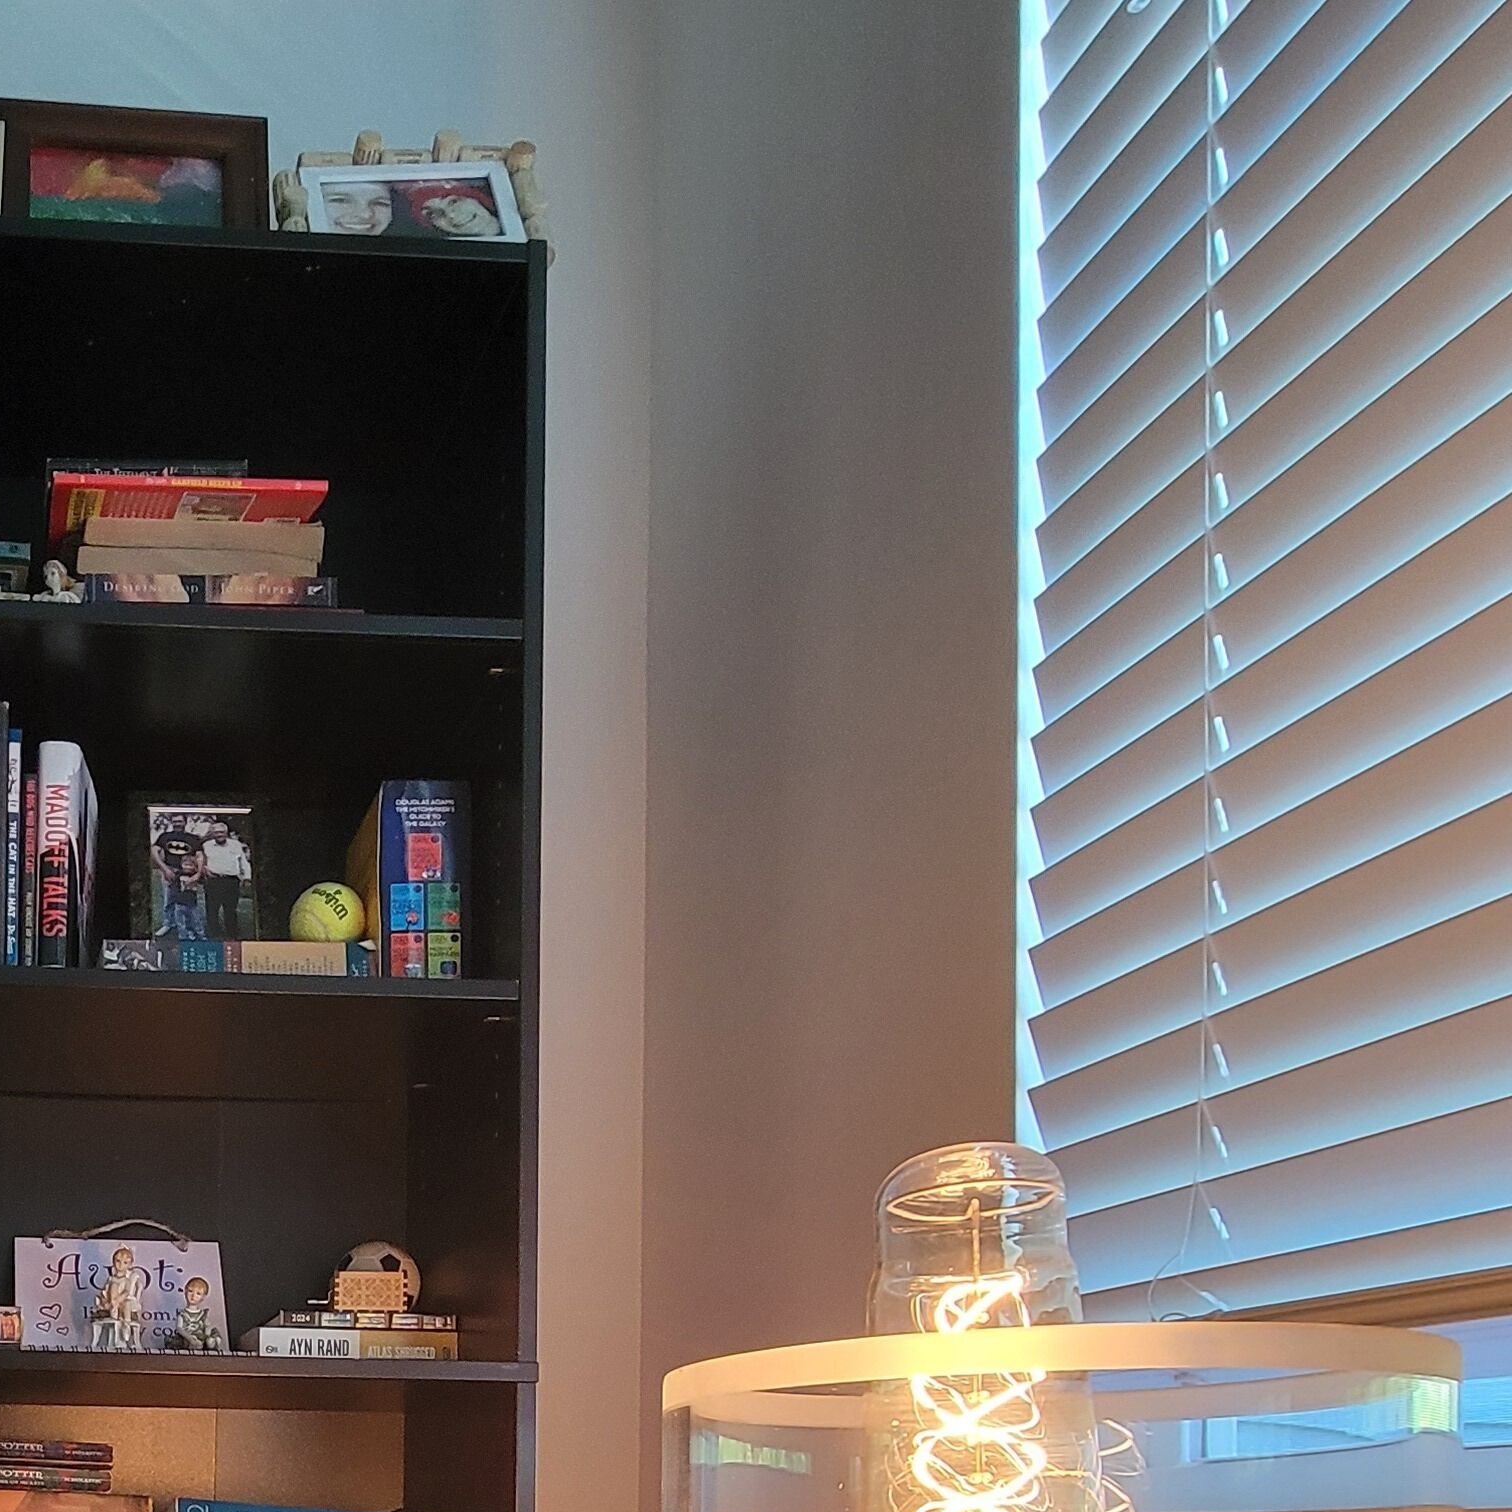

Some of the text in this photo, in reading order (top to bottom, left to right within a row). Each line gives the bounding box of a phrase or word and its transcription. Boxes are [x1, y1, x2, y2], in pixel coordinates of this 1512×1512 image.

[7, 820, 17, 918] THE CAT IN THE HAT
[42, 784, 71, 938] MADOFF TALKS
[291, 1313, 311, 1322] 2024
[289, 1338, 350, 1357] AYN RAND
[367, 1345, 392, 1358] ATLAS
